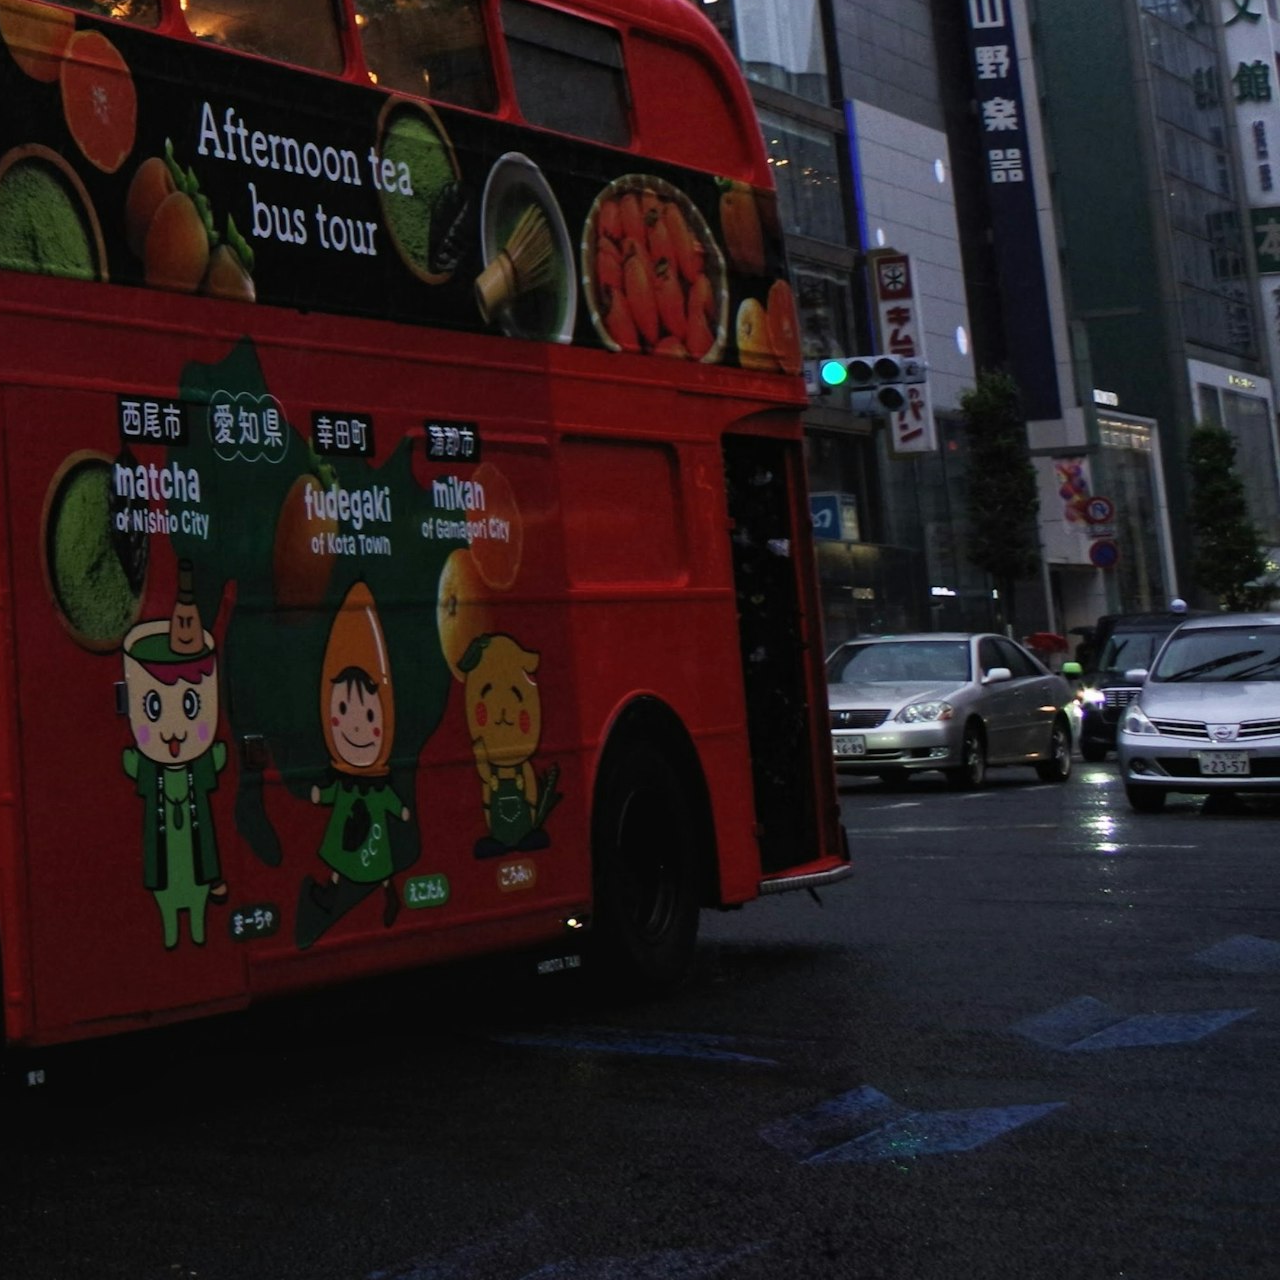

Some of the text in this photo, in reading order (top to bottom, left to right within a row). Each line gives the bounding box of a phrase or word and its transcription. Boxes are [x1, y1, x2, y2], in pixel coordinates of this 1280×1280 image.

[198, 101, 414, 196] Afternoon tea
[248, 182, 378, 256] bus tour
[121, 400, 181, 440] 西尾市
[213, 404, 283, 447] 愛知県
[317, 416, 368, 451] 幸田町
[428, 424, 475, 458] 蒲郡市
[115, 461, 200, 503] matcha
[433, 475, 486, 511] mikan
[116, 507, 209, 540] of Nishio City
[304, 482, 392, 530] fudegaki
[311, 532, 392, 556] of Kota Town
[421, 517, 510, 545] of Gamagori City
[1211, 760, 1246, 773] 23-57
